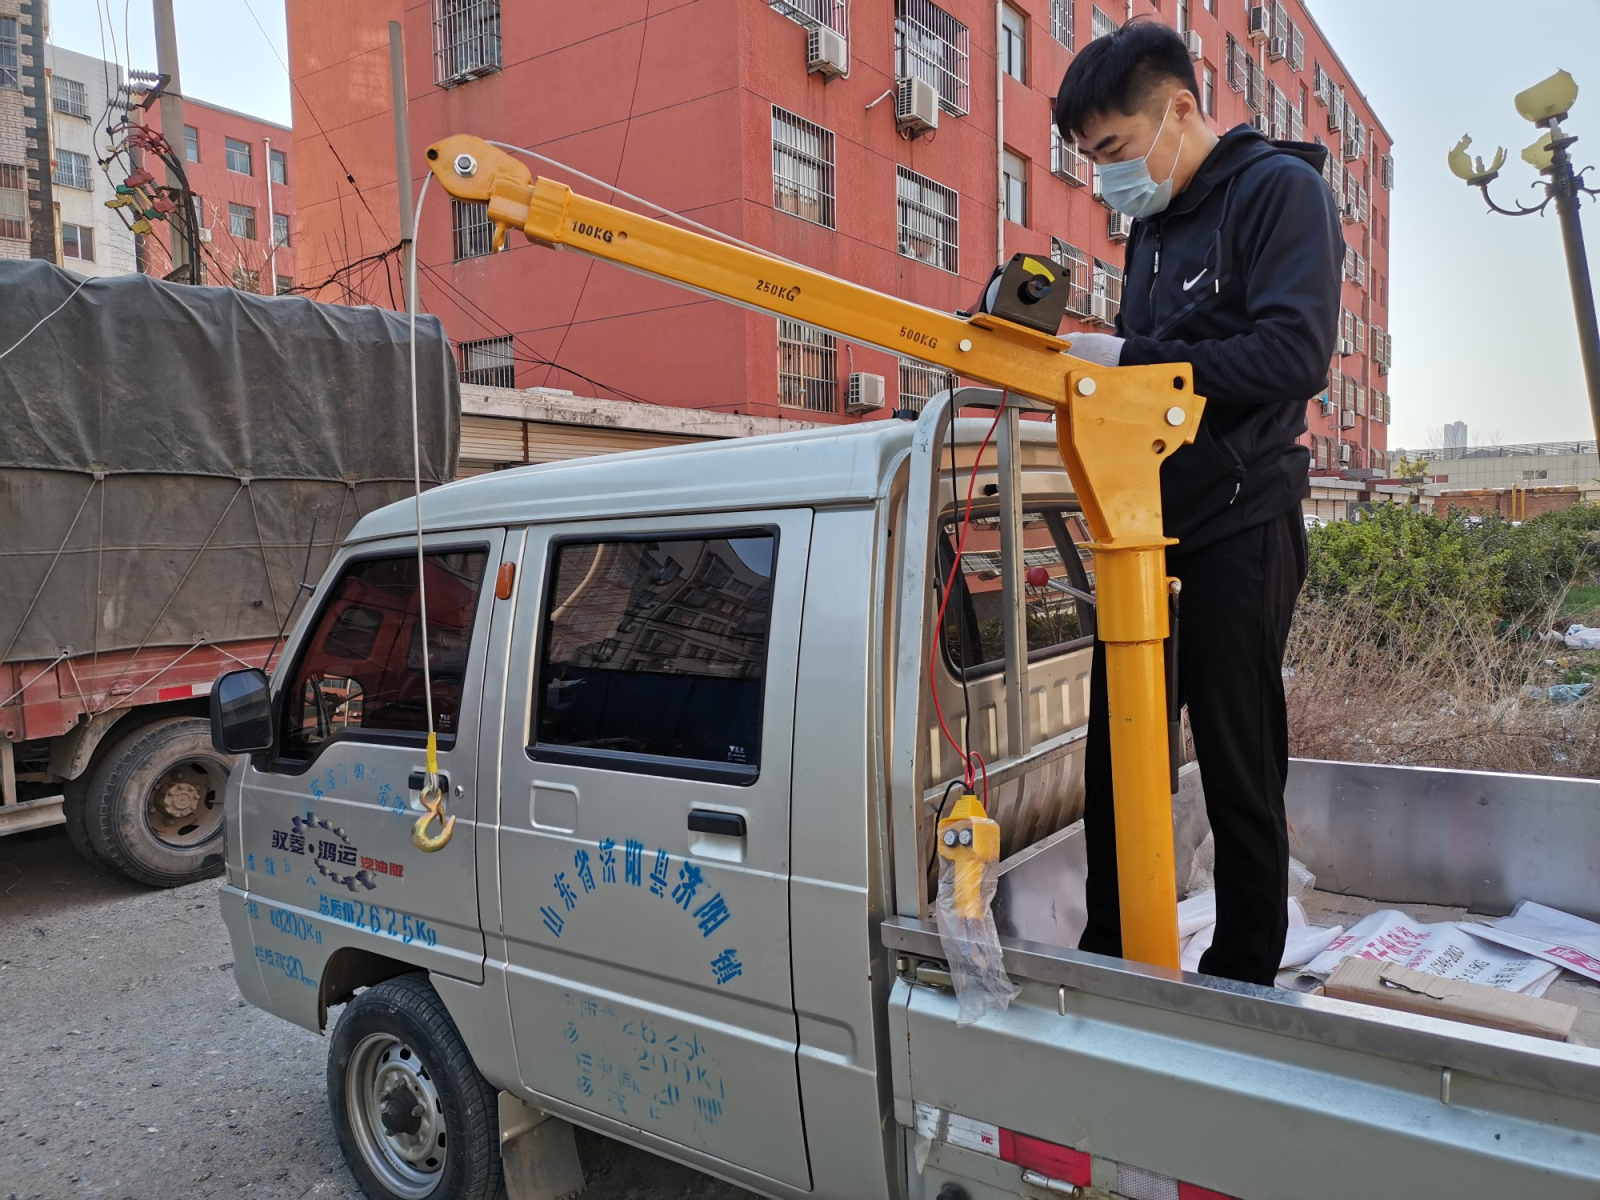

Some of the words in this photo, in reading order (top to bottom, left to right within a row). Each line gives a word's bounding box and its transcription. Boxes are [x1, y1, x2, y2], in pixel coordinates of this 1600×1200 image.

[572, 221, 613, 243] 100KG
[756, 280, 795, 301] 250KG
[900, 326, 938, 348] 500KG
[361, 856, 404, 878] 汽油版
